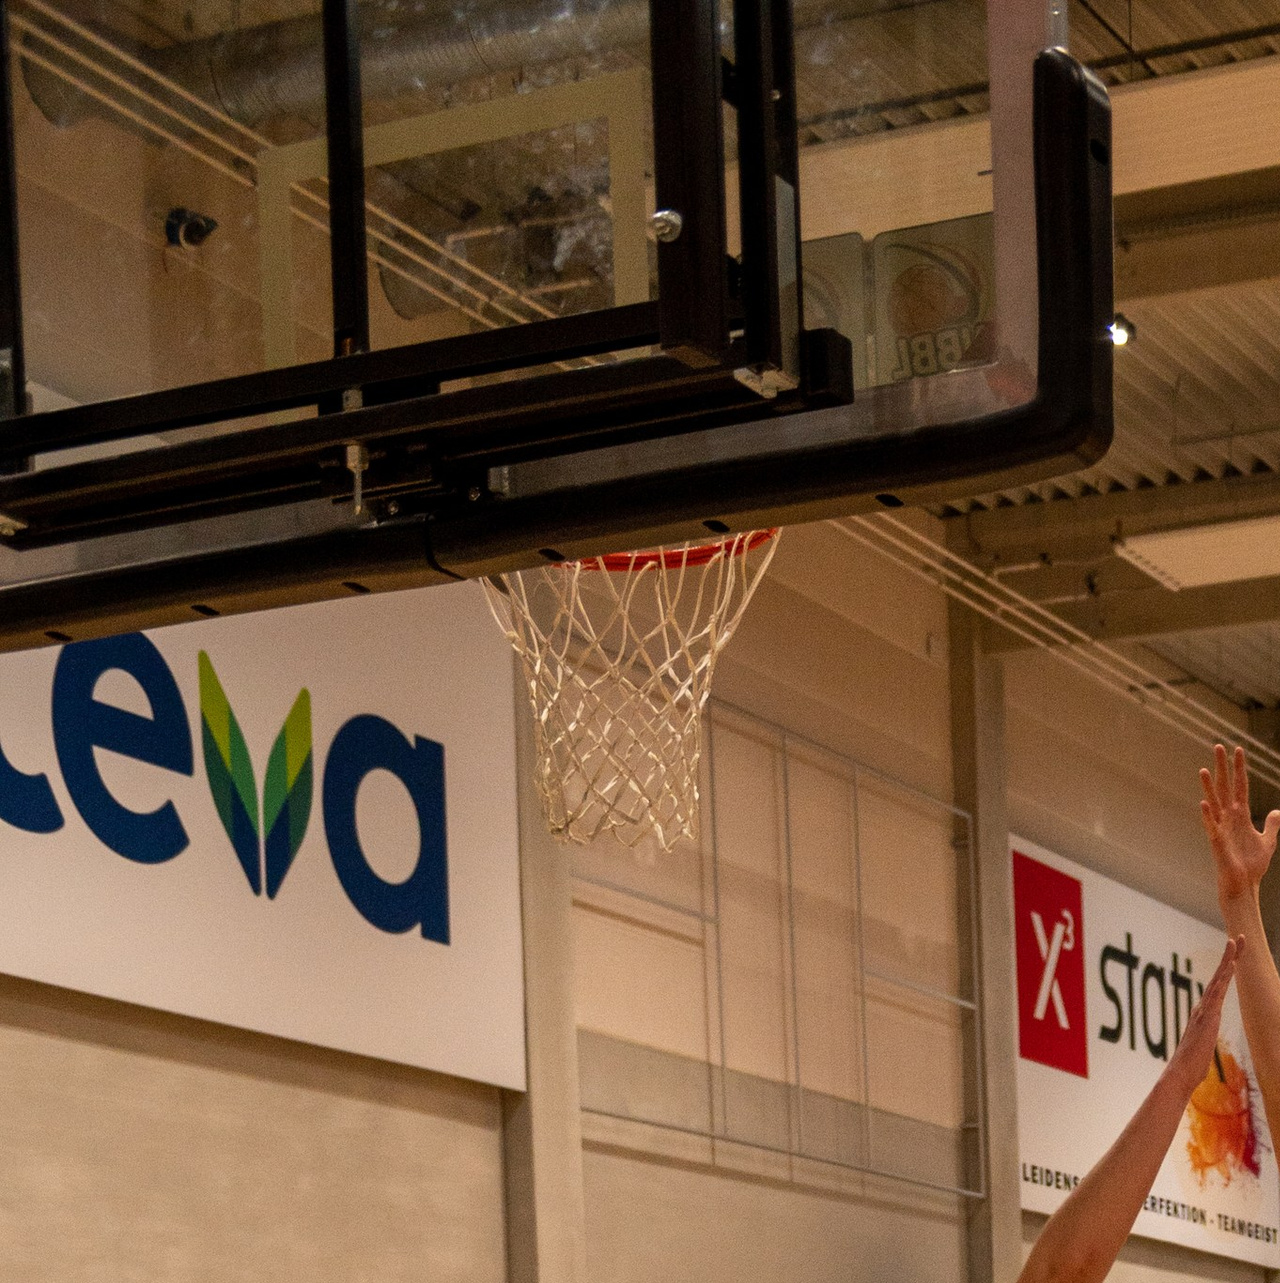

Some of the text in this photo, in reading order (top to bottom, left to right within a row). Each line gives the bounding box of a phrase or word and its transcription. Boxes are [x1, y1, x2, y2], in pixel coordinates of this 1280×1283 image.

[0, 631, 451, 946] eva
[1098, 931, 1226, 1083] stati
[1022, 1162, 1080, 1192] LEIDENS
[1143, 1195, 1207, 1226] ERFEKTION
[1218, 1213, 1278, 1245] TEAMGEIST
